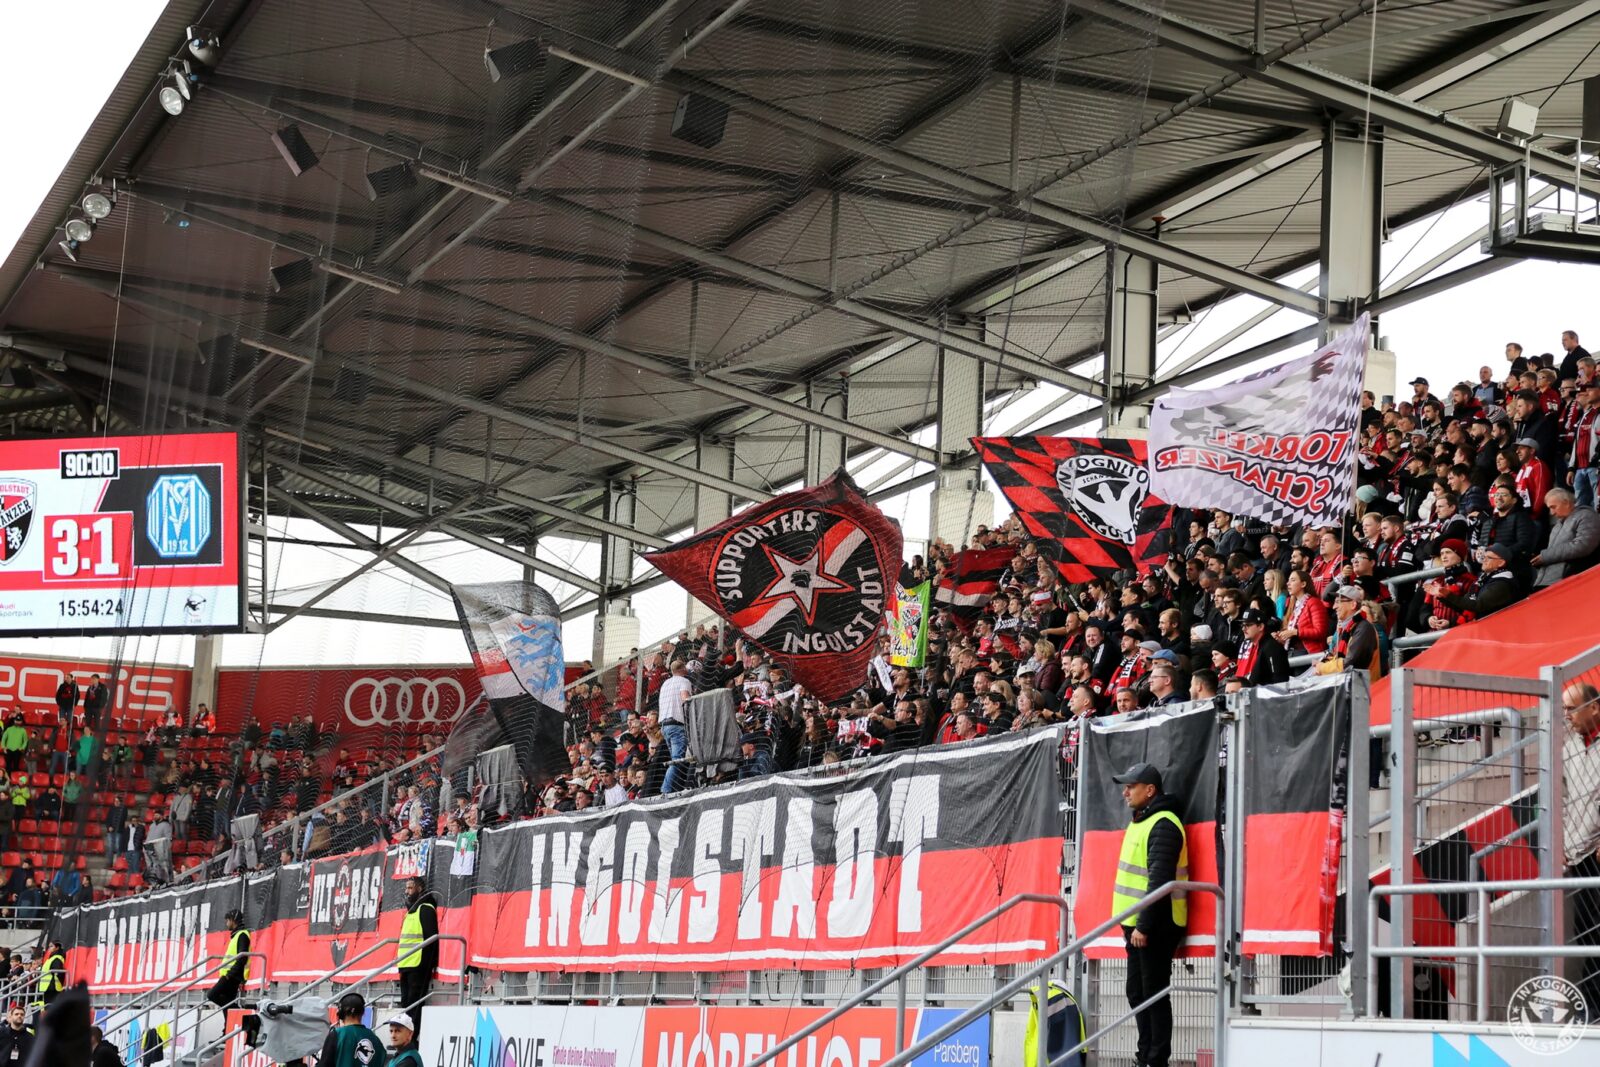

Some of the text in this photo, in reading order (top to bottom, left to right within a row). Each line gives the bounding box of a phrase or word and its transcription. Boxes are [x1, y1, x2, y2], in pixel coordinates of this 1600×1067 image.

[66, 453, 114, 476] 90:00
[52, 518, 119, 576] 3:1
[716, 510, 820, 600] SUPPORTERS
[59, 600, 124, 617] 15:54:24
[782, 566, 883, 654] INGOLSTADT
[524, 774, 941, 948] INGOLSTADT
[934, 1039, 980, 1067] Parsberg
